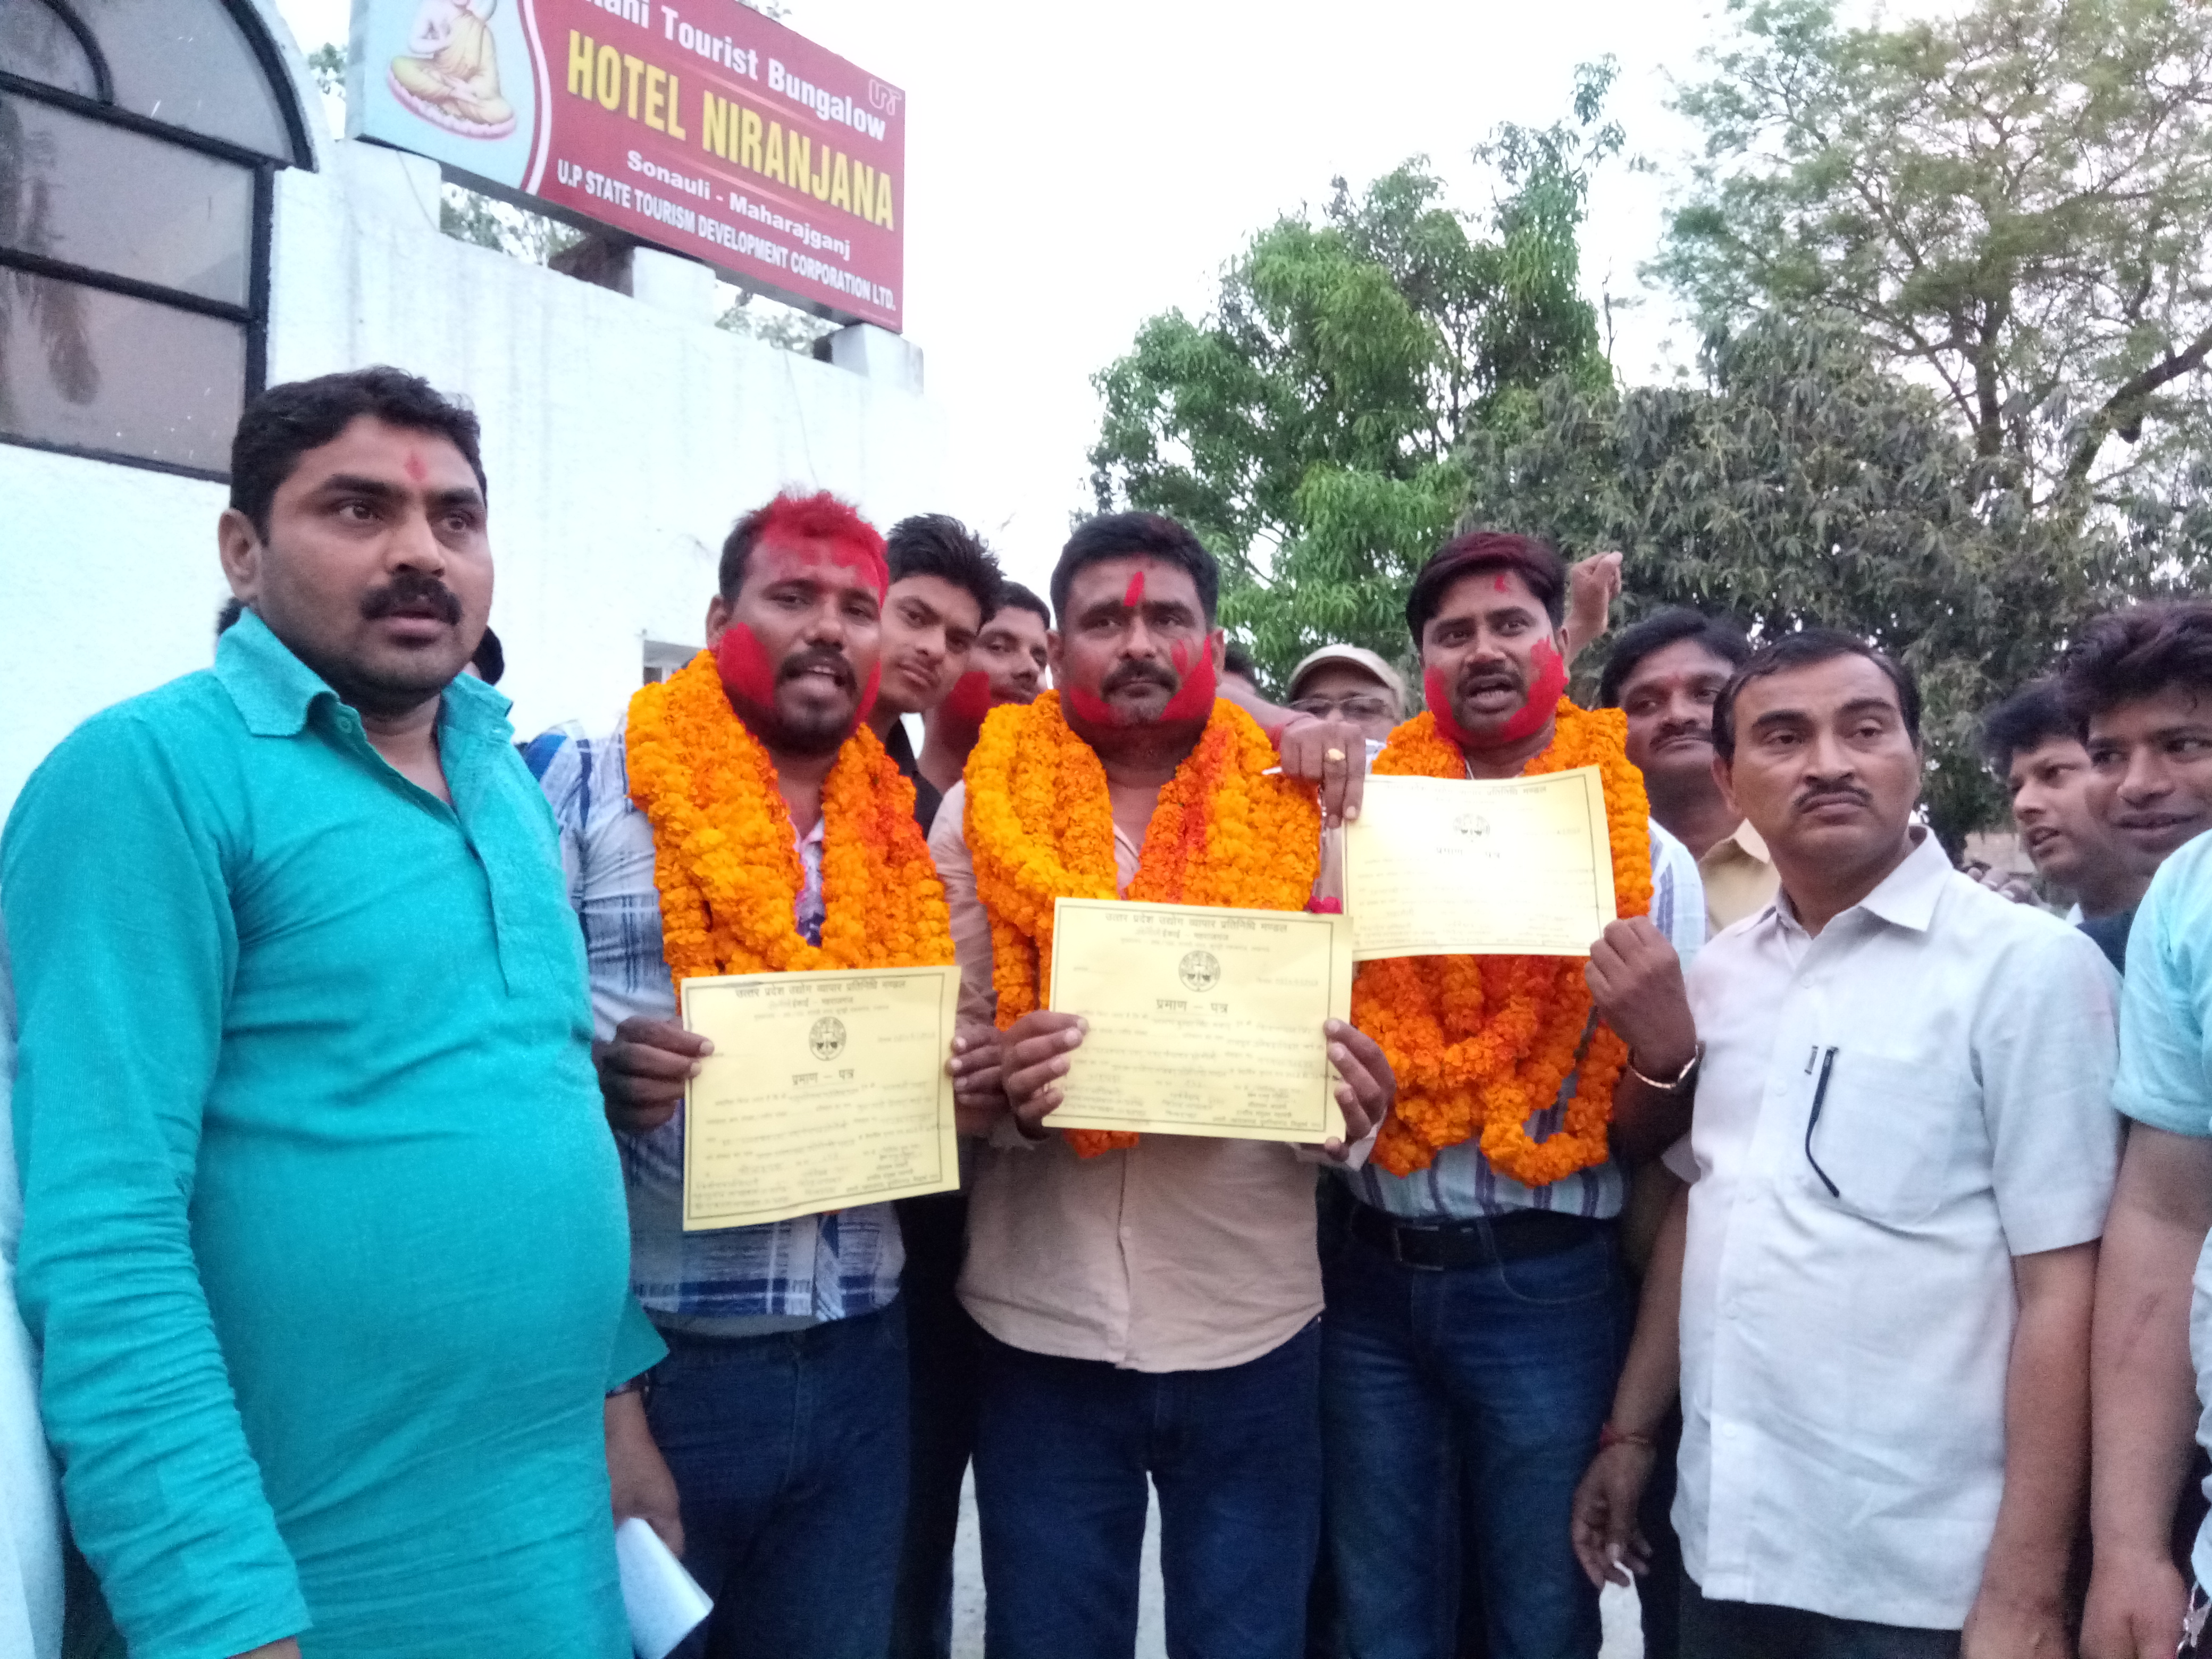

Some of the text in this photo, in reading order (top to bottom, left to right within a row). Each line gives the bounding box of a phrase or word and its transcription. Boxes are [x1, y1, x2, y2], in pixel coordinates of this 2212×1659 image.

[661, 5, 759, 81] Tourist
[768, 57, 886, 142] Bungalow
[567, 29, 894, 231] HOTEL NIRANJANA
[557, 158, 896, 312] U.P STATE TOURISM DEVELOPMENT CORPORATION LTD.
[627, 149, 711, 201] Sonauli
[729, 191, 850, 261] Maharajganj
[1133, 912, 1154, 924] प्रदेश
[1189, 919, 1216, 928] व्यापार
[765, 983, 784, 996] प्रदेश
[816, 983, 842, 992] व्यापार
[1155, 999, 1188, 1012] प्रमाण
[1211, 1003, 1228, 1013] पत्र
[792, 1072, 818, 1086] प्रमाण
[838, 1068, 854, 1080] पत्र
